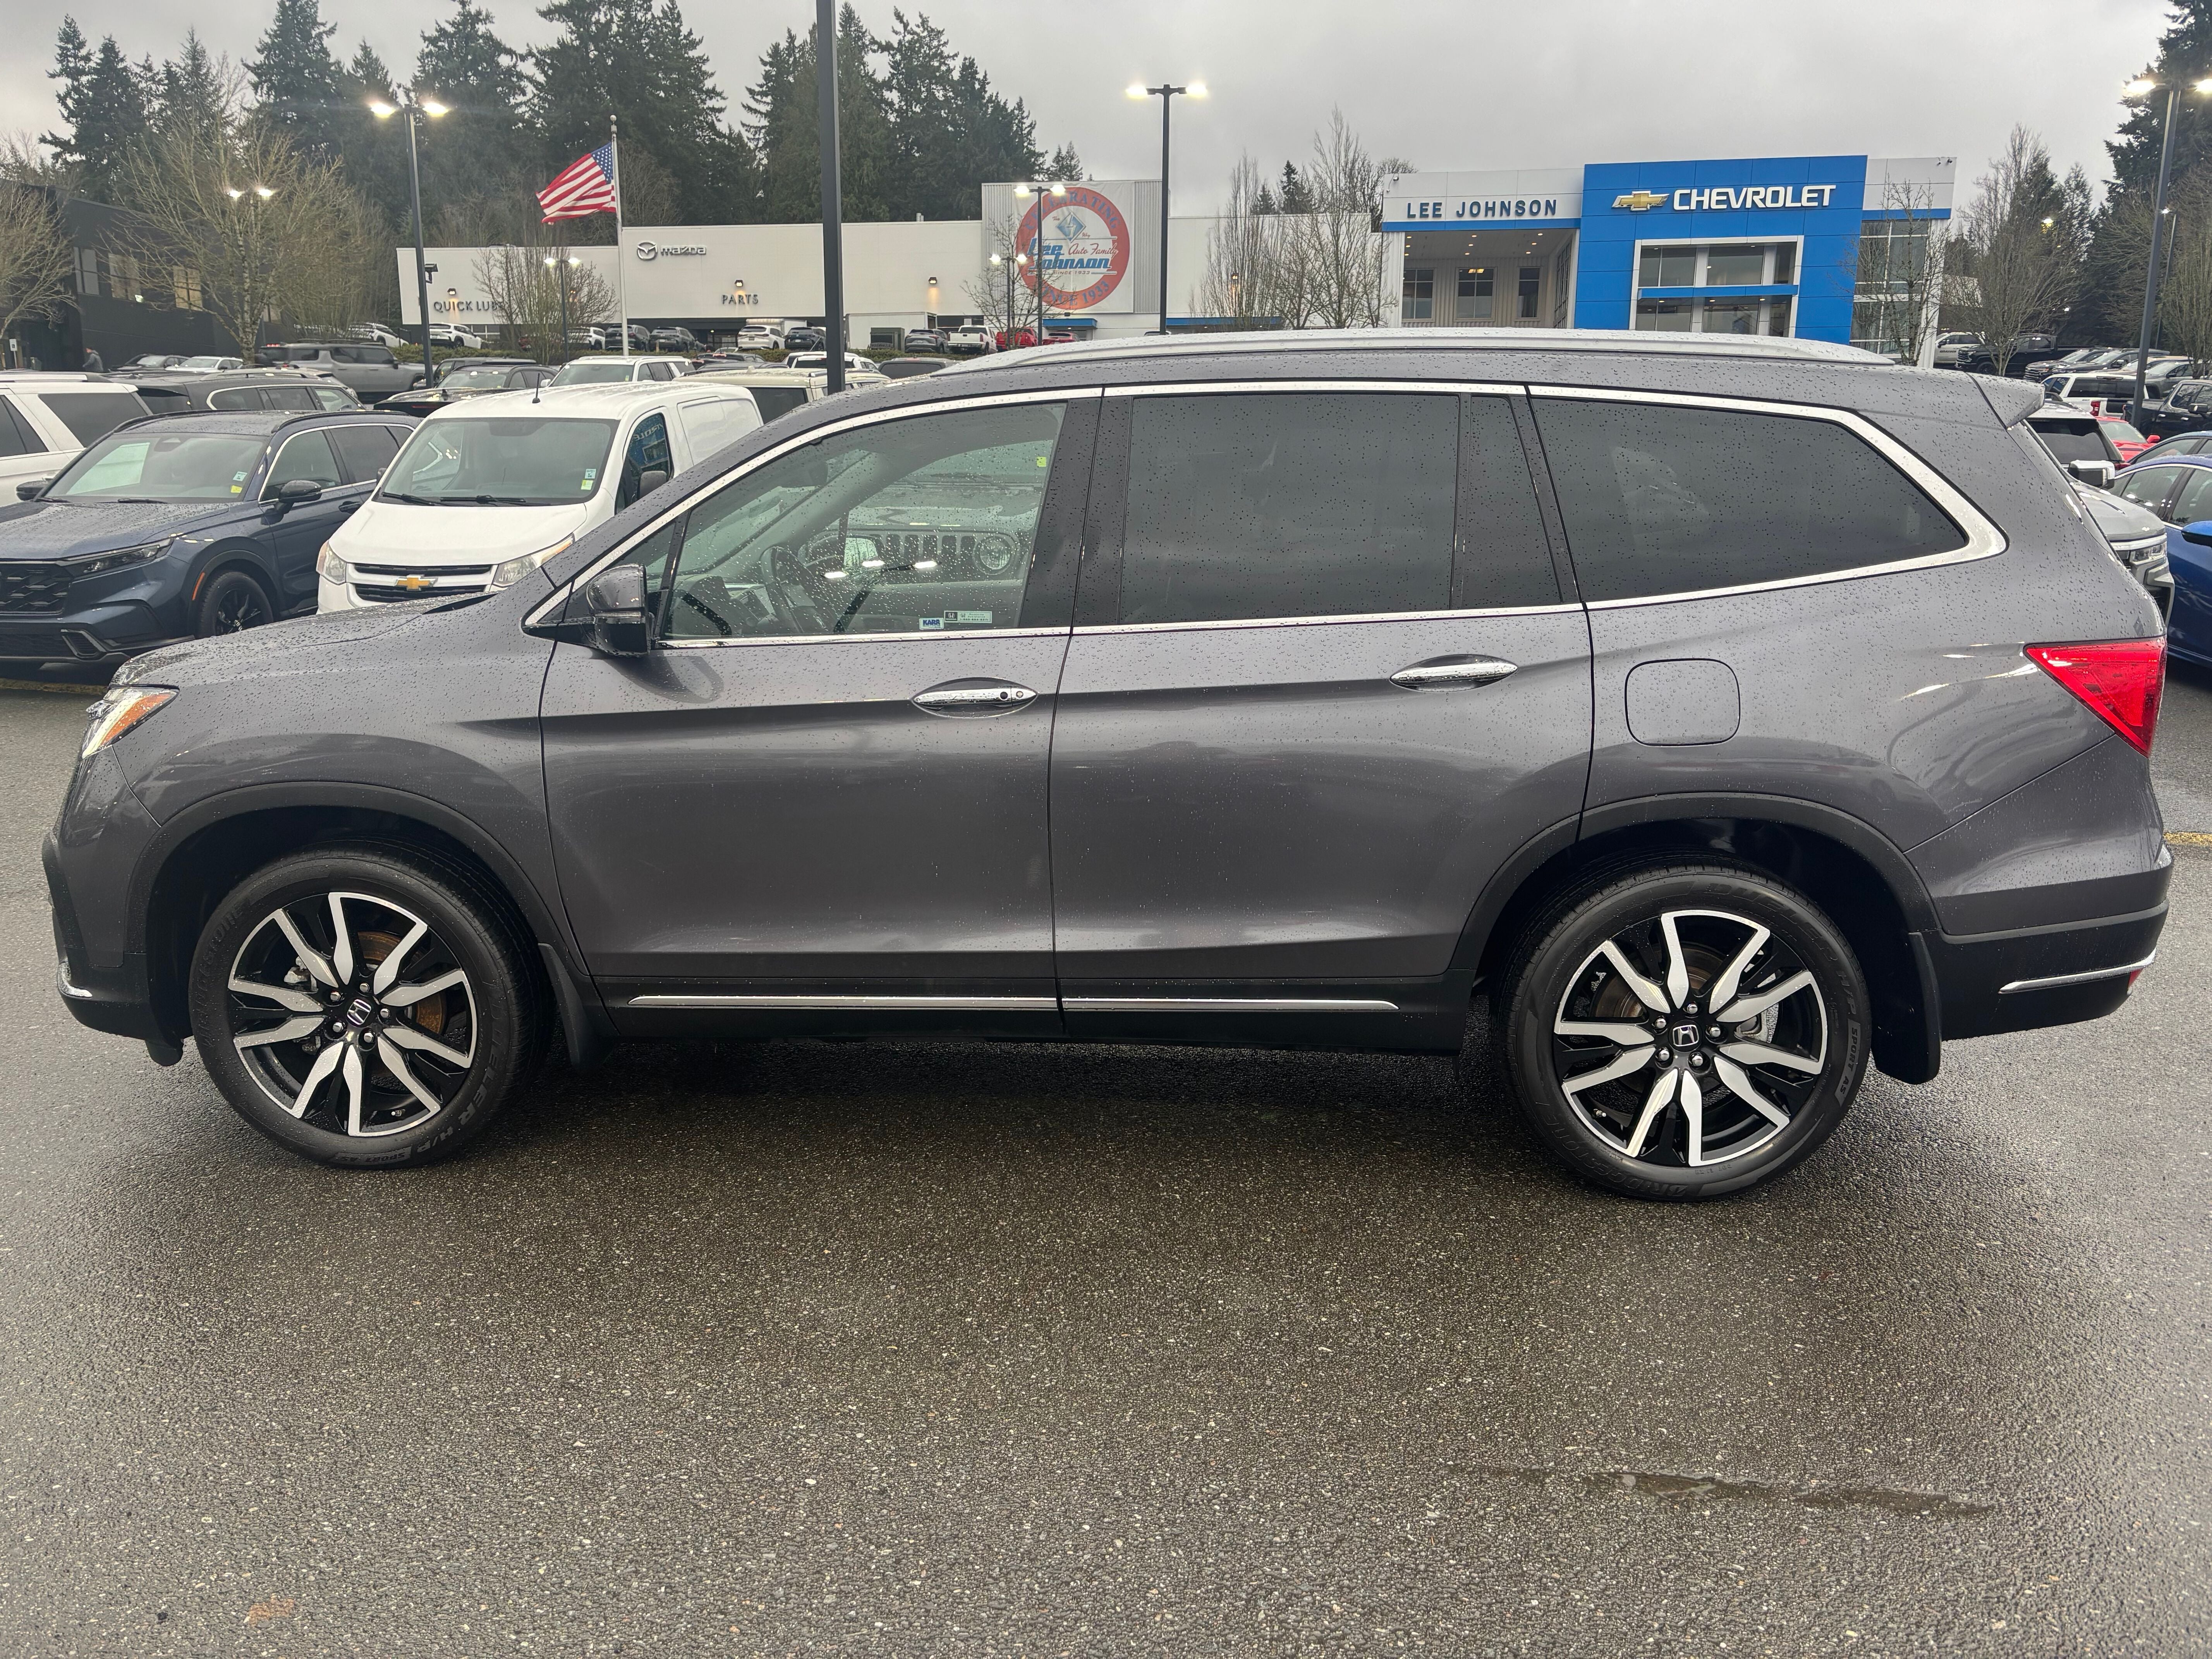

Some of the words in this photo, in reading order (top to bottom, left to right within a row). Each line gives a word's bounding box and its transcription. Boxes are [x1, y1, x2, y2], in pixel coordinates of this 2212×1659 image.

[1673, 185, 1836, 210] CHEVROLET
[1407, 203, 1442, 218] LEE
[1456, 199, 1556, 217] JOHNSON
[661, 245, 707, 256] mazda
[1027, 238, 1065, 256] Lee
[1068, 243, 1088, 255] Auto
[1090, 243, 1118, 259] Family
[721, 294, 759, 304] PARTS
[1082, 280, 1109, 304] 1933
[434, 301, 473, 313] QUICK
[1848, 1027, 1858, 1071] SPORT
[1840, 1076, 1849, 1094] AS
